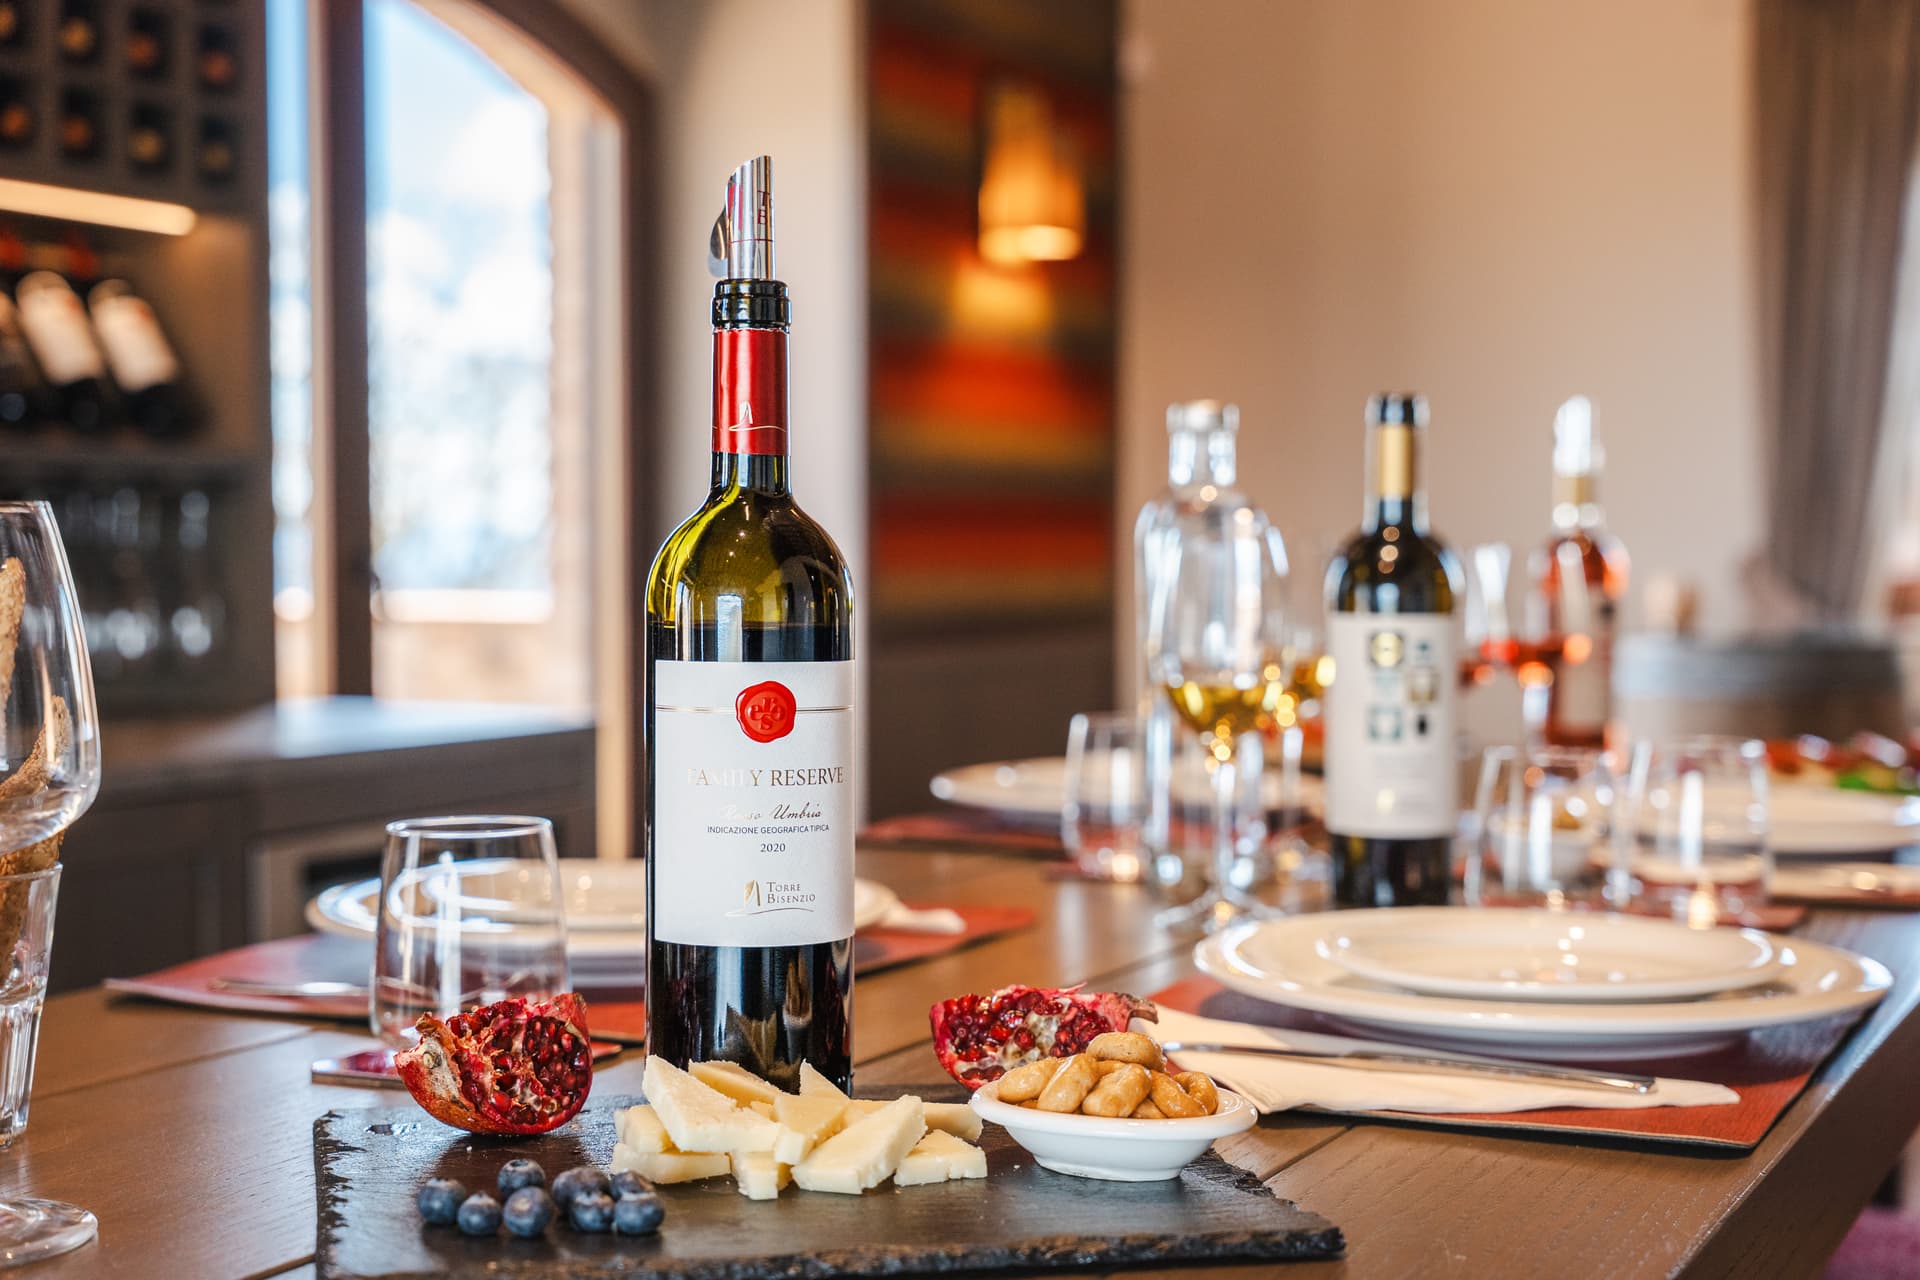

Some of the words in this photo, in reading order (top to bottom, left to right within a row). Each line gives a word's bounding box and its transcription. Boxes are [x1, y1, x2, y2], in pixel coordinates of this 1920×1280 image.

[771, 766, 844, 786] RESERVE
[707, 826, 759, 834] INDICAZIONE
[760, 825, 809, 835] GEOGRAFICA
[810, 824, 830, 833] TIPICA
[760, 843, 786, 853] 2020
[766, 881, 801, 893] TORRE
[766, 893, 816, 904] BISENZIO
